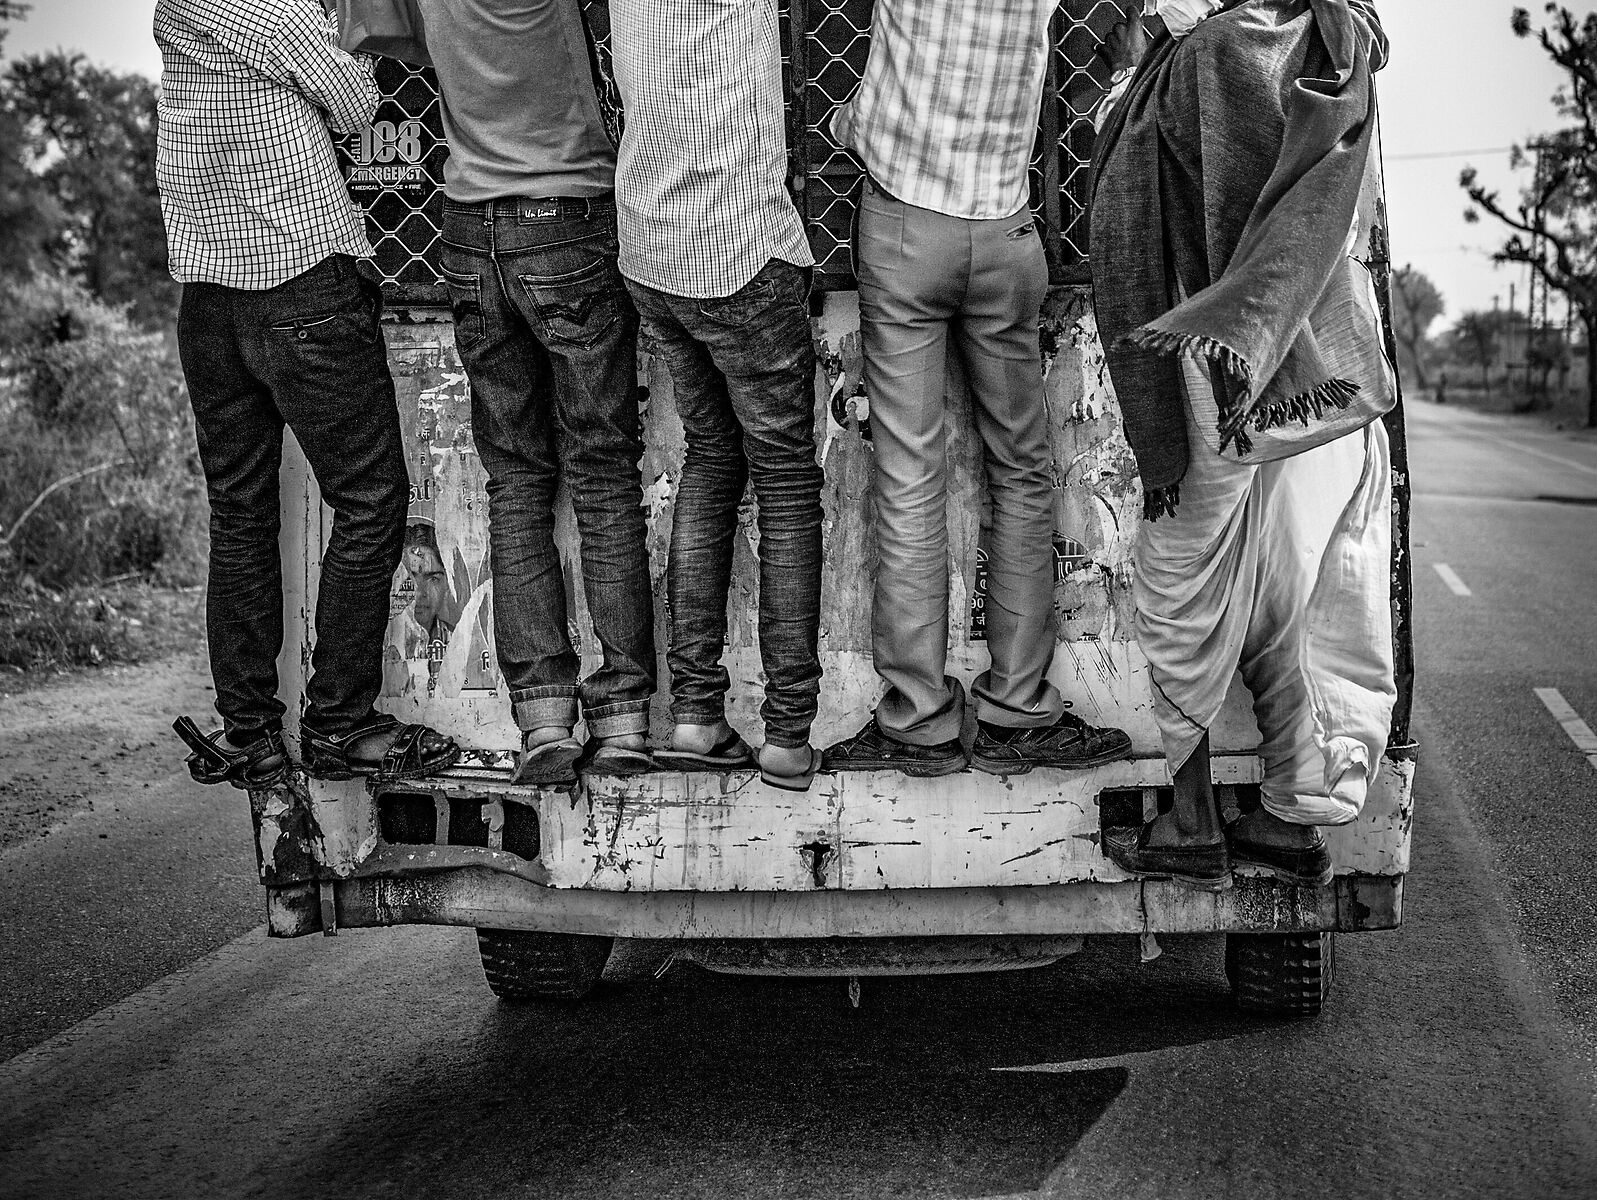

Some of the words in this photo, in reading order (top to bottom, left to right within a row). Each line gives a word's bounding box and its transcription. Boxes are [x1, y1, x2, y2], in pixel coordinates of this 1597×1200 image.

[350, 136, 361, 162] CALL
[360, 120, 421, 163] 108
[351, 166, 421, 181] EMERGENCY
